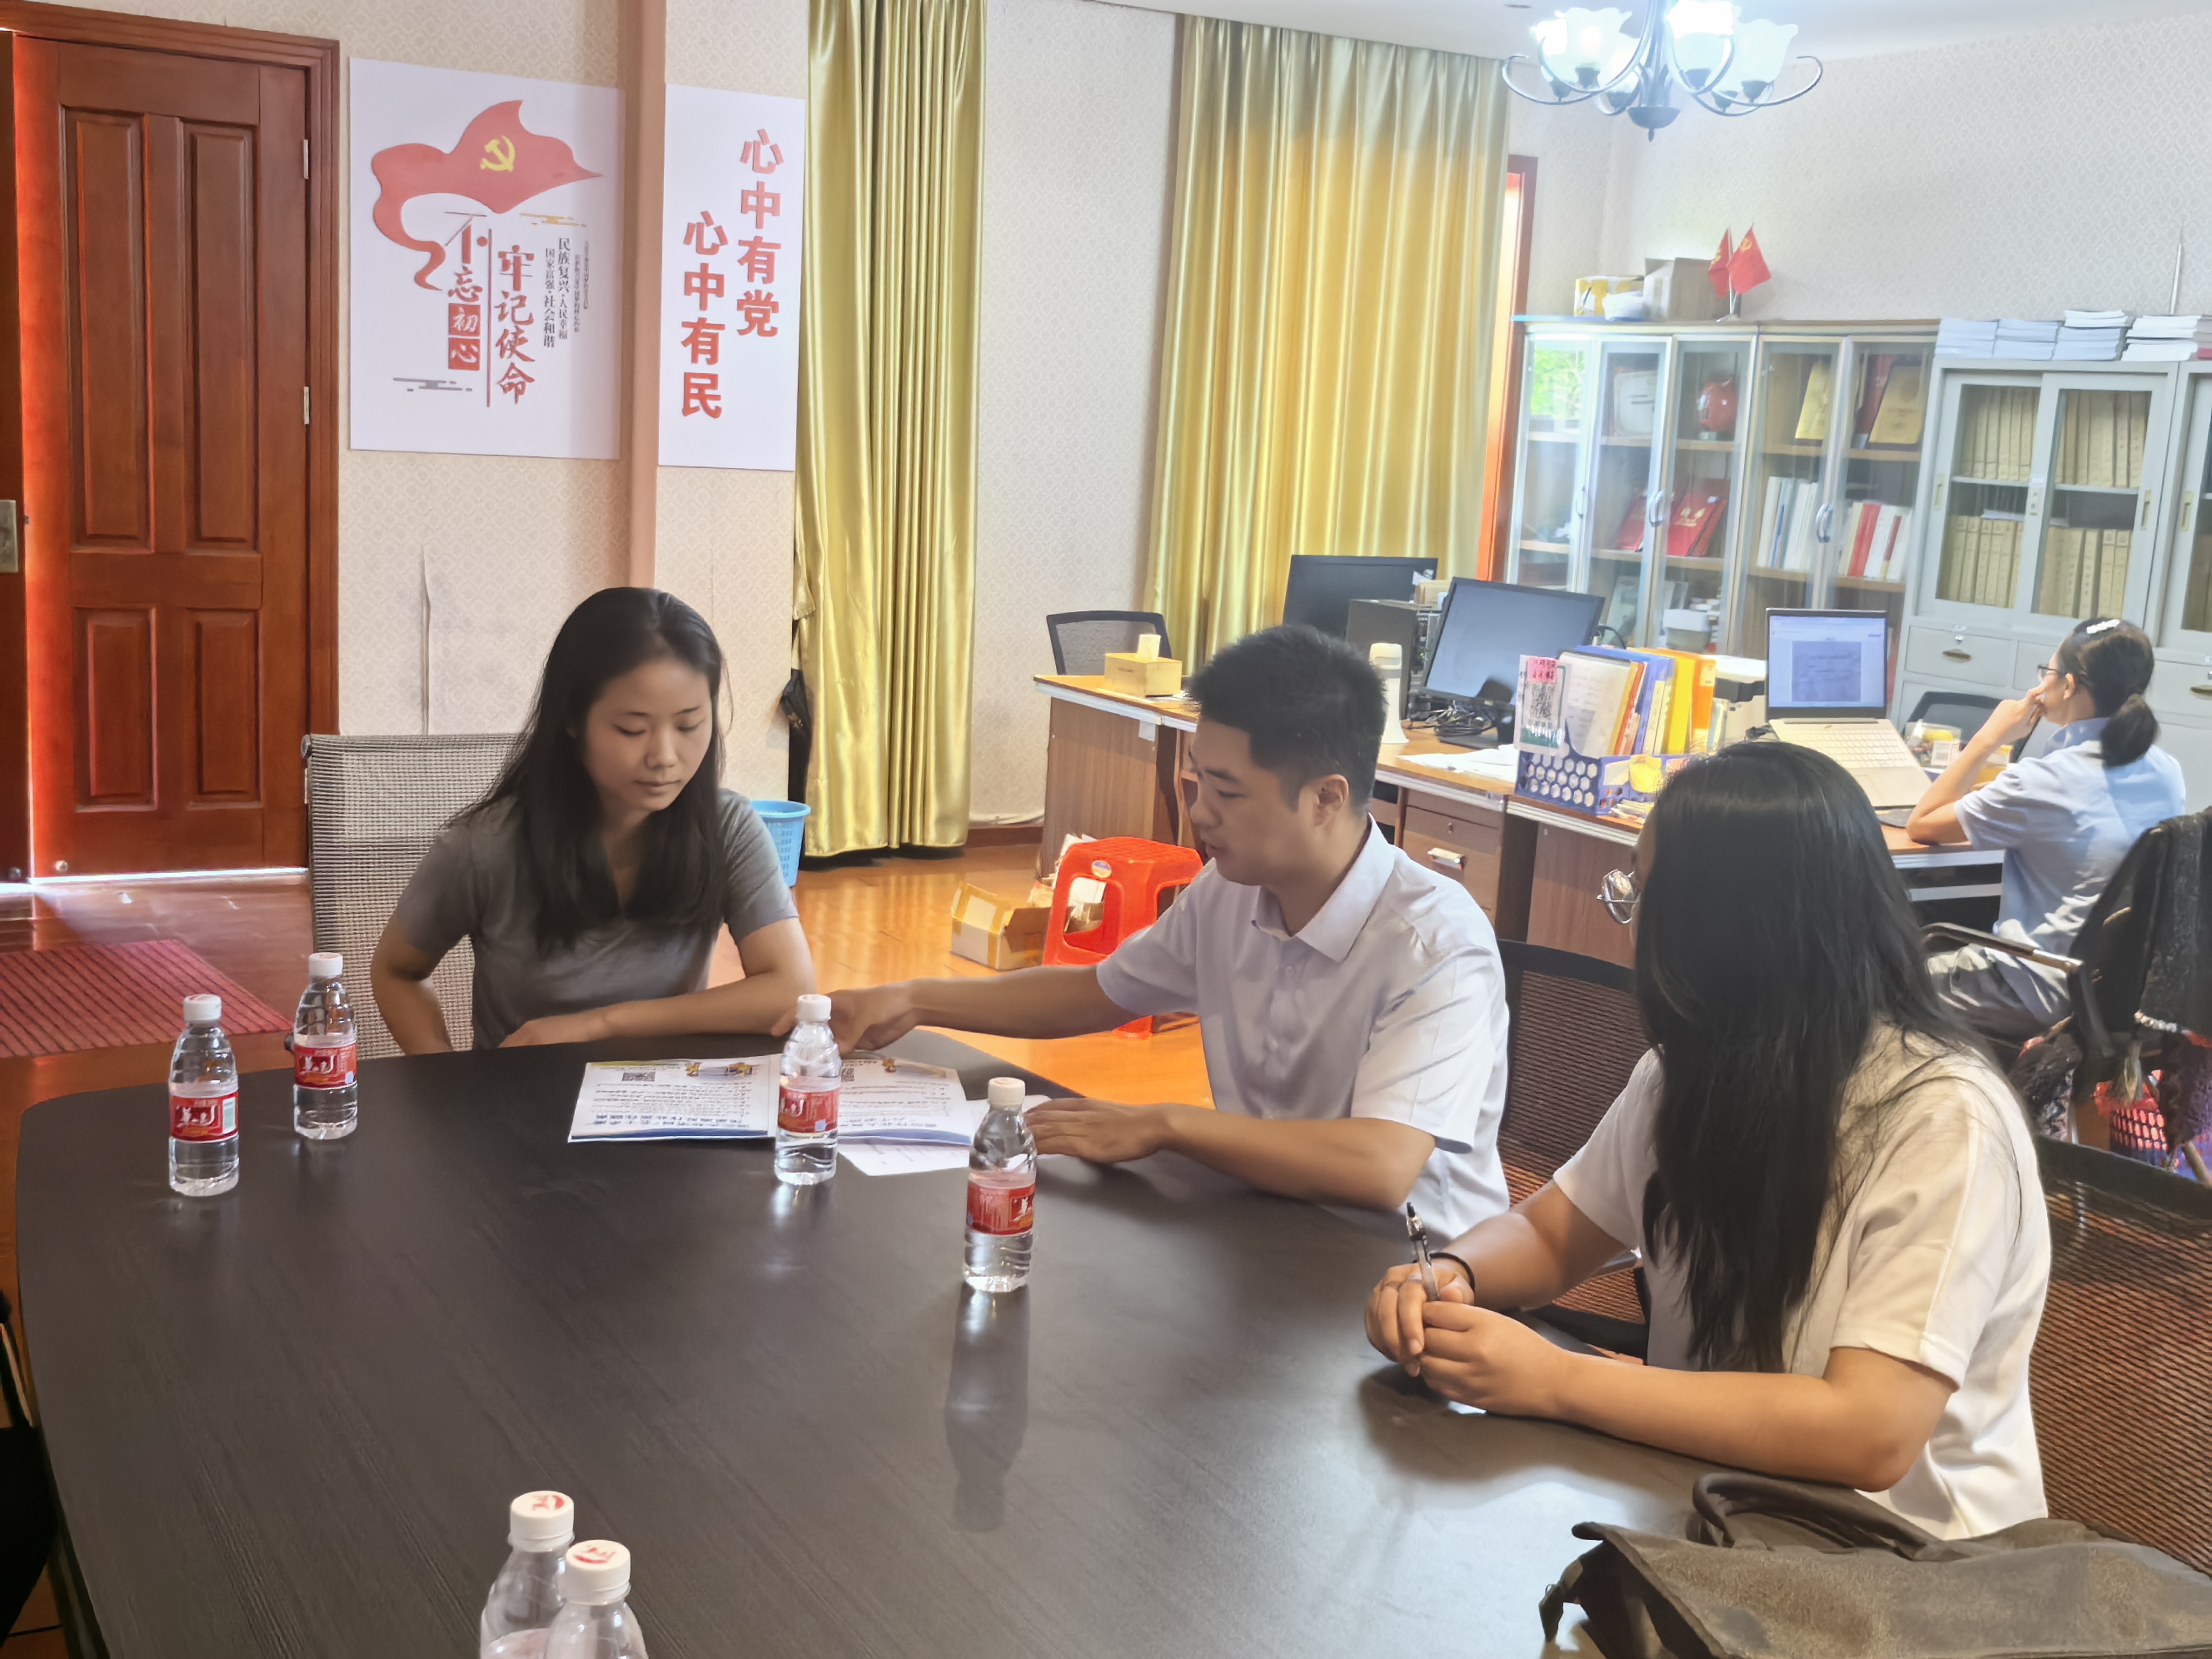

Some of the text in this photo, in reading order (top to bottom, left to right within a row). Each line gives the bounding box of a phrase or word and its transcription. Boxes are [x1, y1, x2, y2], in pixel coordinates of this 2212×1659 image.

[445, 211, 488, 369] 不忘初心
[494, 244, 535, 405] 牢记使命
[681, 210, 729, 419] 心中有民
[737, 128, 784, 338] 心中有党
